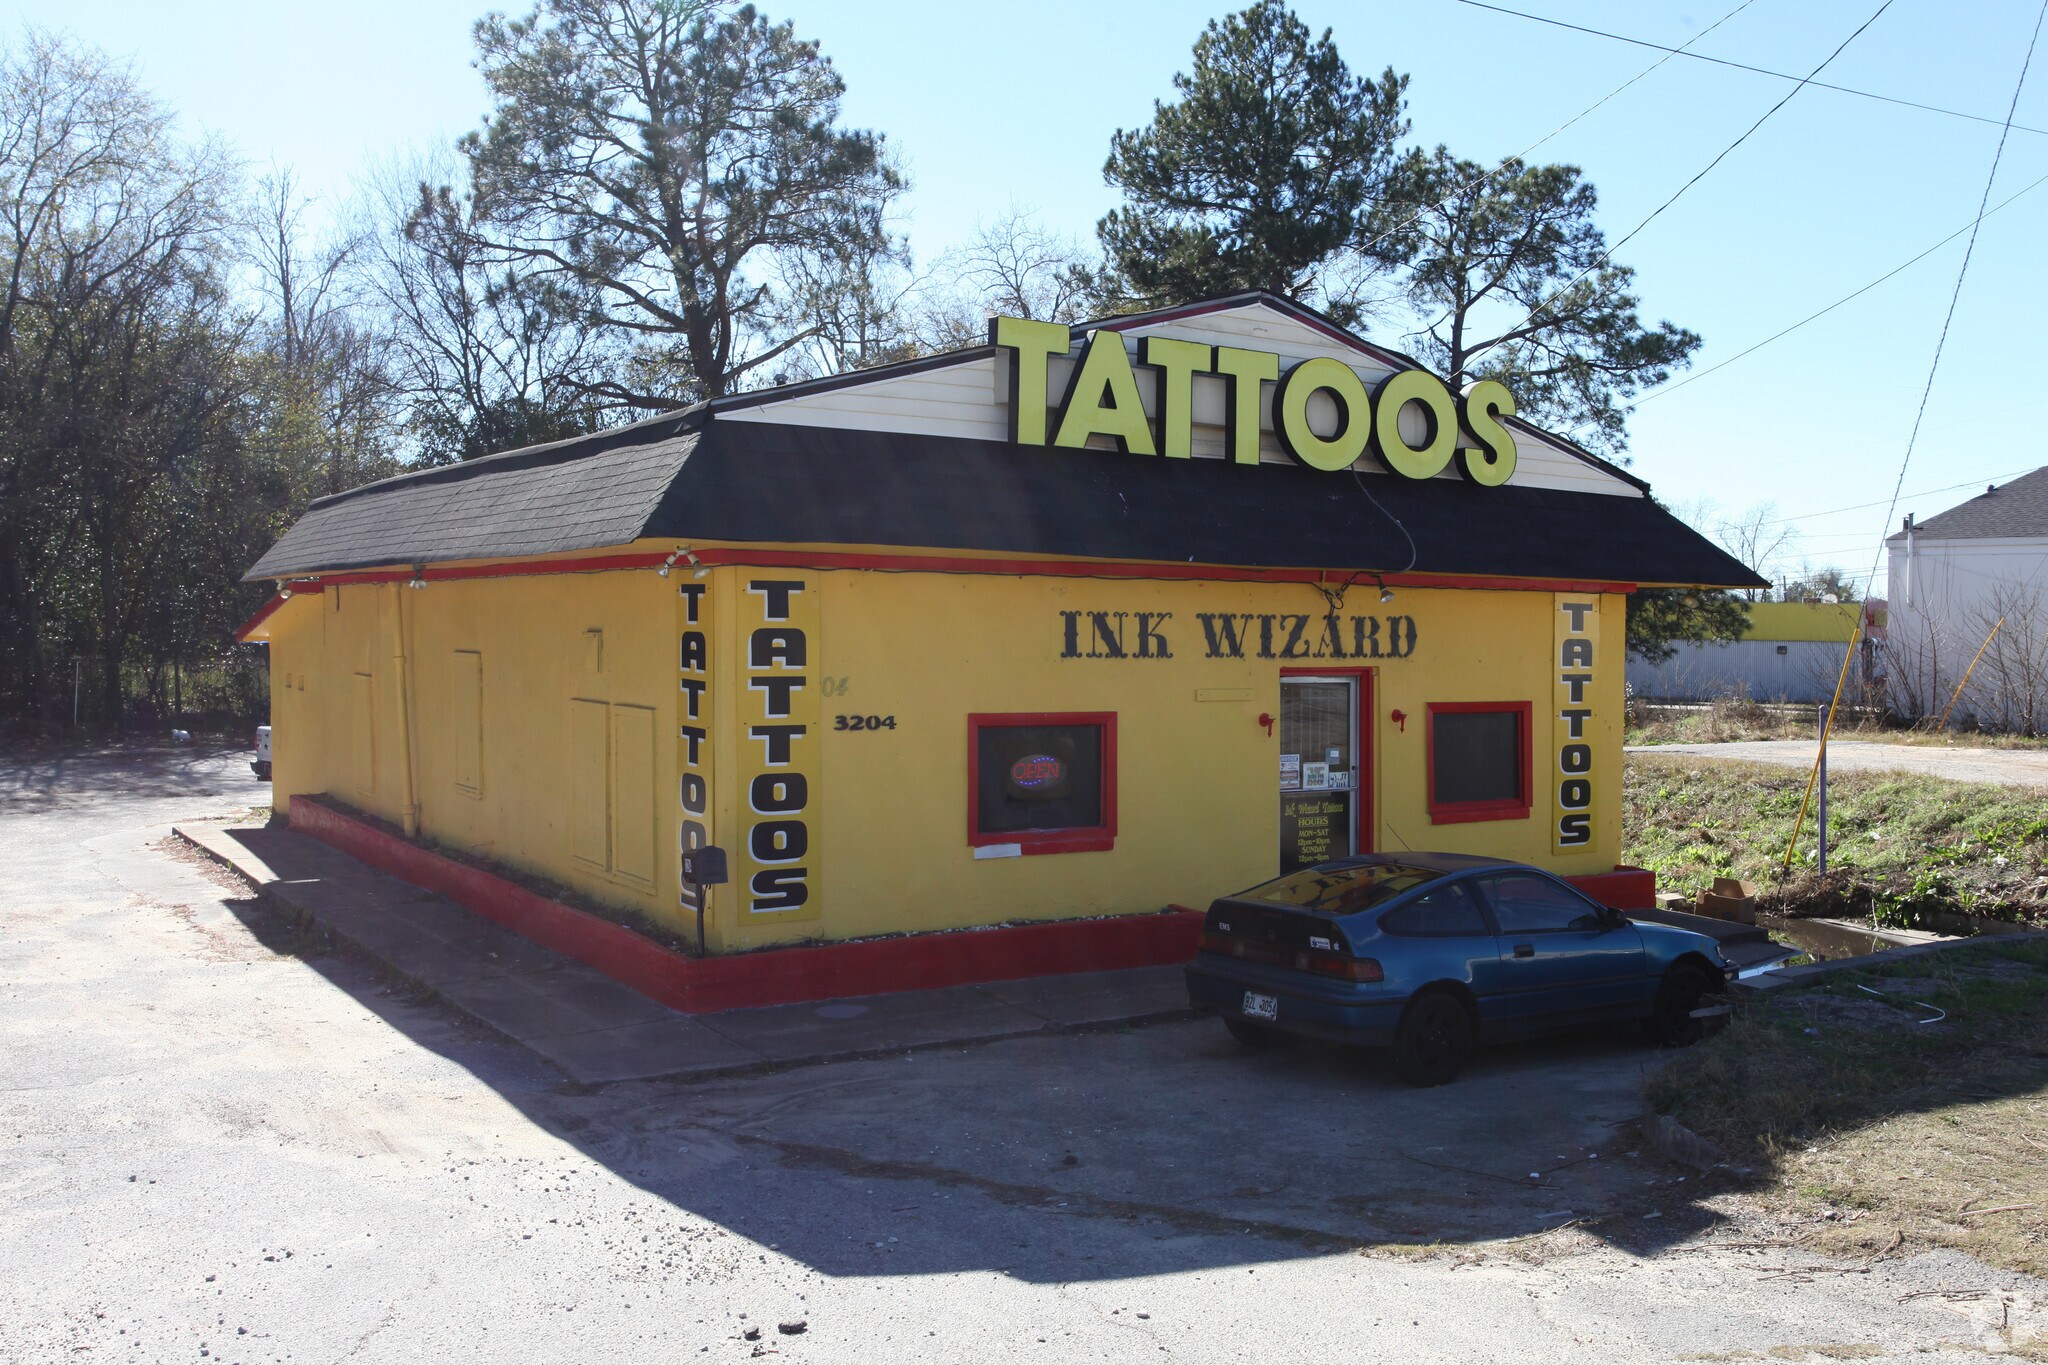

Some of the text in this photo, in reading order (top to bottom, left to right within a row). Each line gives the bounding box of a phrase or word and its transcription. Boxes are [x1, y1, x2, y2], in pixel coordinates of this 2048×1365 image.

[989, 316, 1517, 487] TATTOOS
[1060, 610, 1418, 660] INK WIZARD
[834, 715, 897, 731] 3204
[1559, 602, 1593, 847] TATTOOS
[747, 580, 808, 913] TATTOOS
[1013, 763, 1060, 780] OPEN
[1298, 816, 1329, 826] HOURS
[1299, 828, 1329, 837] MON-SAT
[1301, 845, 1327, 854] SUNDAY
[1219, 922, 1231, 931] EMS
